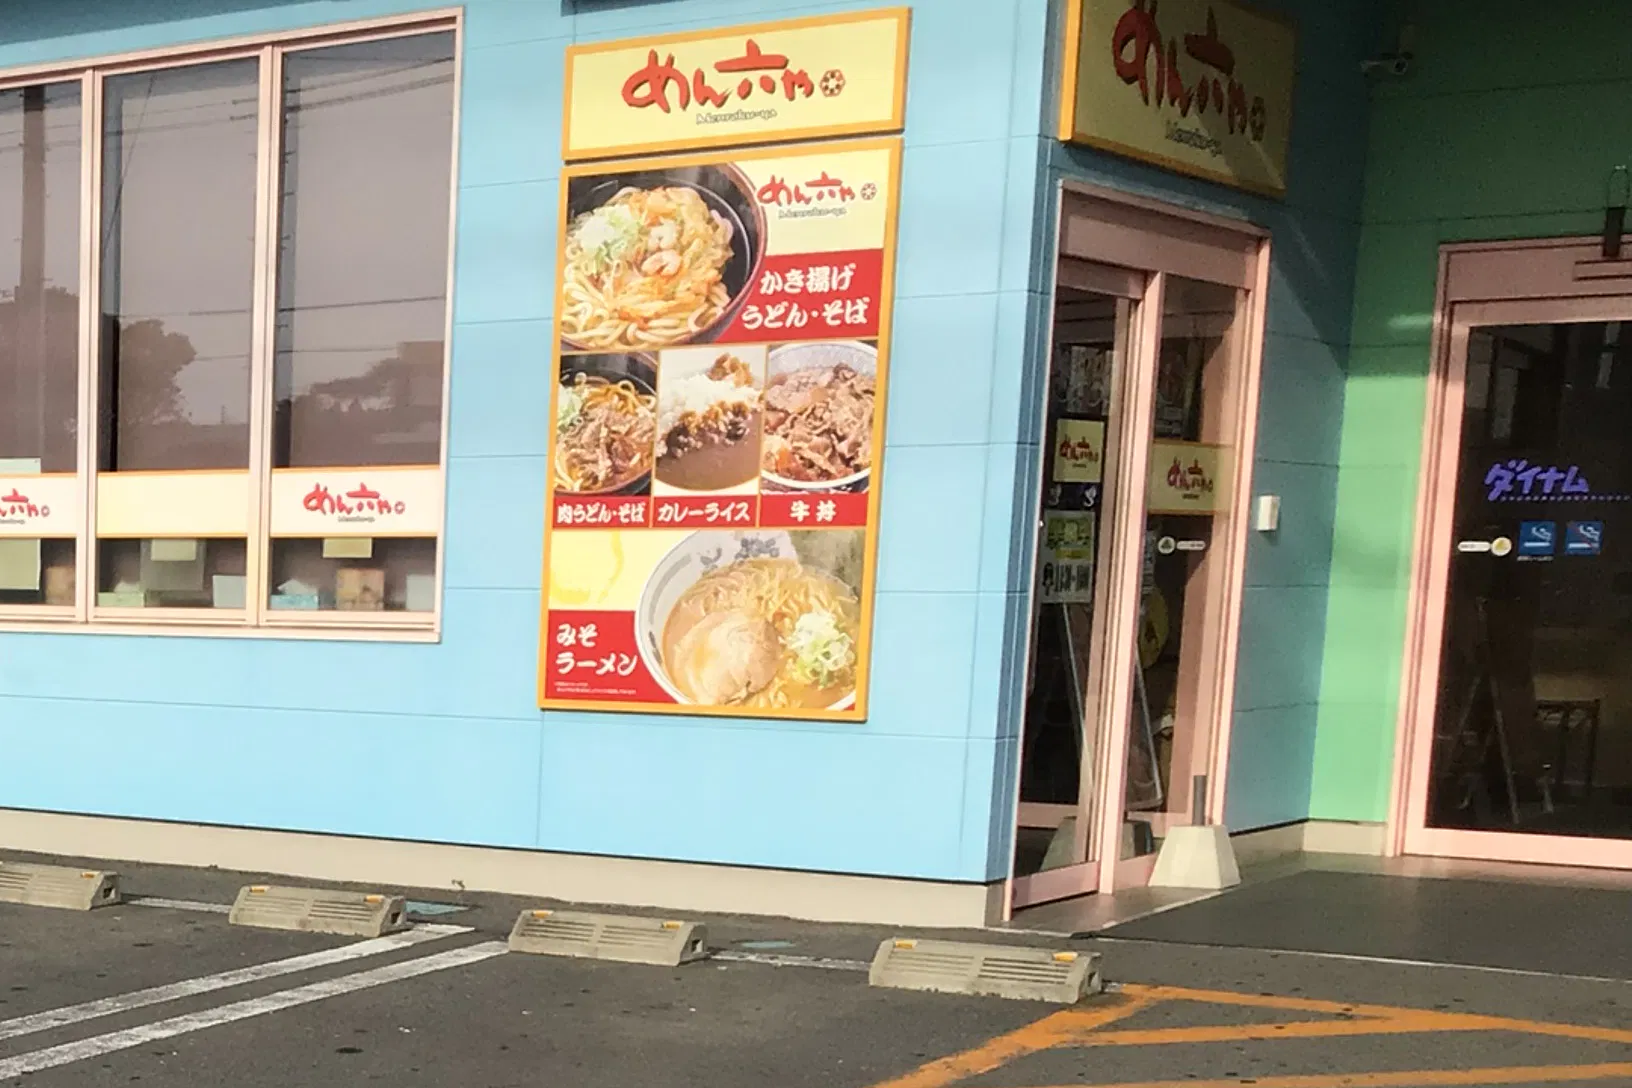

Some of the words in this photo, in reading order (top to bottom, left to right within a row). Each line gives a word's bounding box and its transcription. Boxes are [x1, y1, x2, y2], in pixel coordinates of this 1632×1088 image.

[621, 39, 814, 113] めん六や
[757, 171, 856, 206] めん六や
[759, 262, 857, 296] かき揚げ
[741, 296, 871, 330] うどん・そば
[1484, 459, 1590, 502] ダイナム
[556, 500, 646, 524] 肉うどん・そば
[657, 501, 751, 523] カレーライス
[555, 623, 598, 648] みそ
[555, 651, 638, 677] ラーメン
